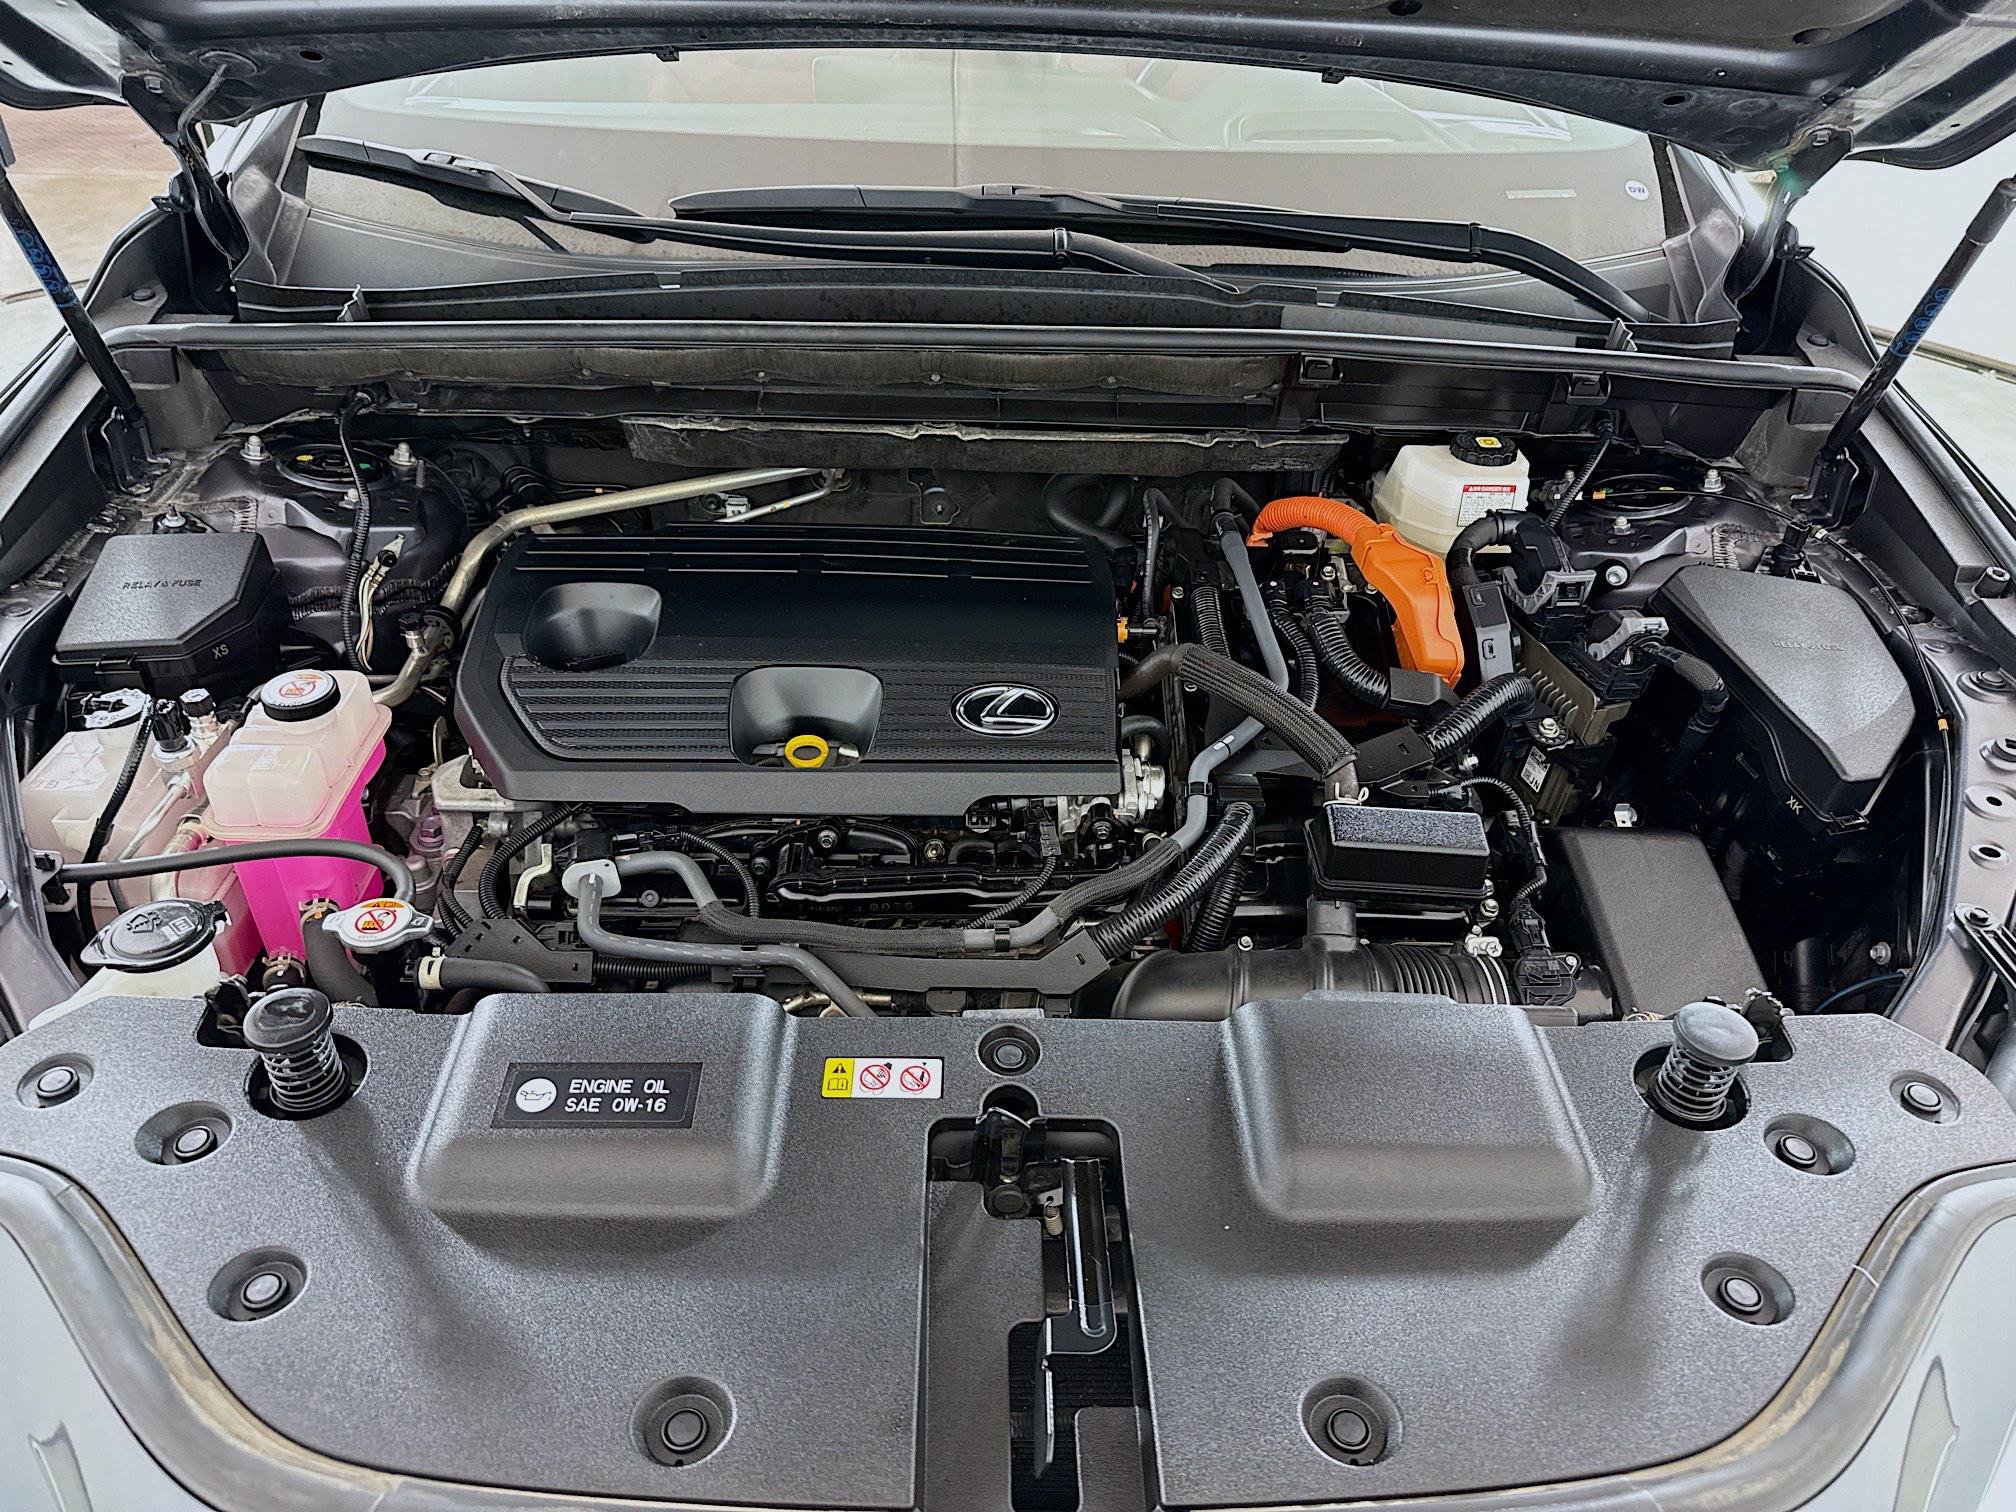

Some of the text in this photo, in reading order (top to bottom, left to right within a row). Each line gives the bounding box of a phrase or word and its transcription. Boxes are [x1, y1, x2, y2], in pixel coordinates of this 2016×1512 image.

[212, 644, 229, 659] XS
[1786, 795, 1803, 815] XK
[569, 1079, 670, 1094] ENGINE OIL
[565, 1098, 667, 1113] SAE 0W-16
